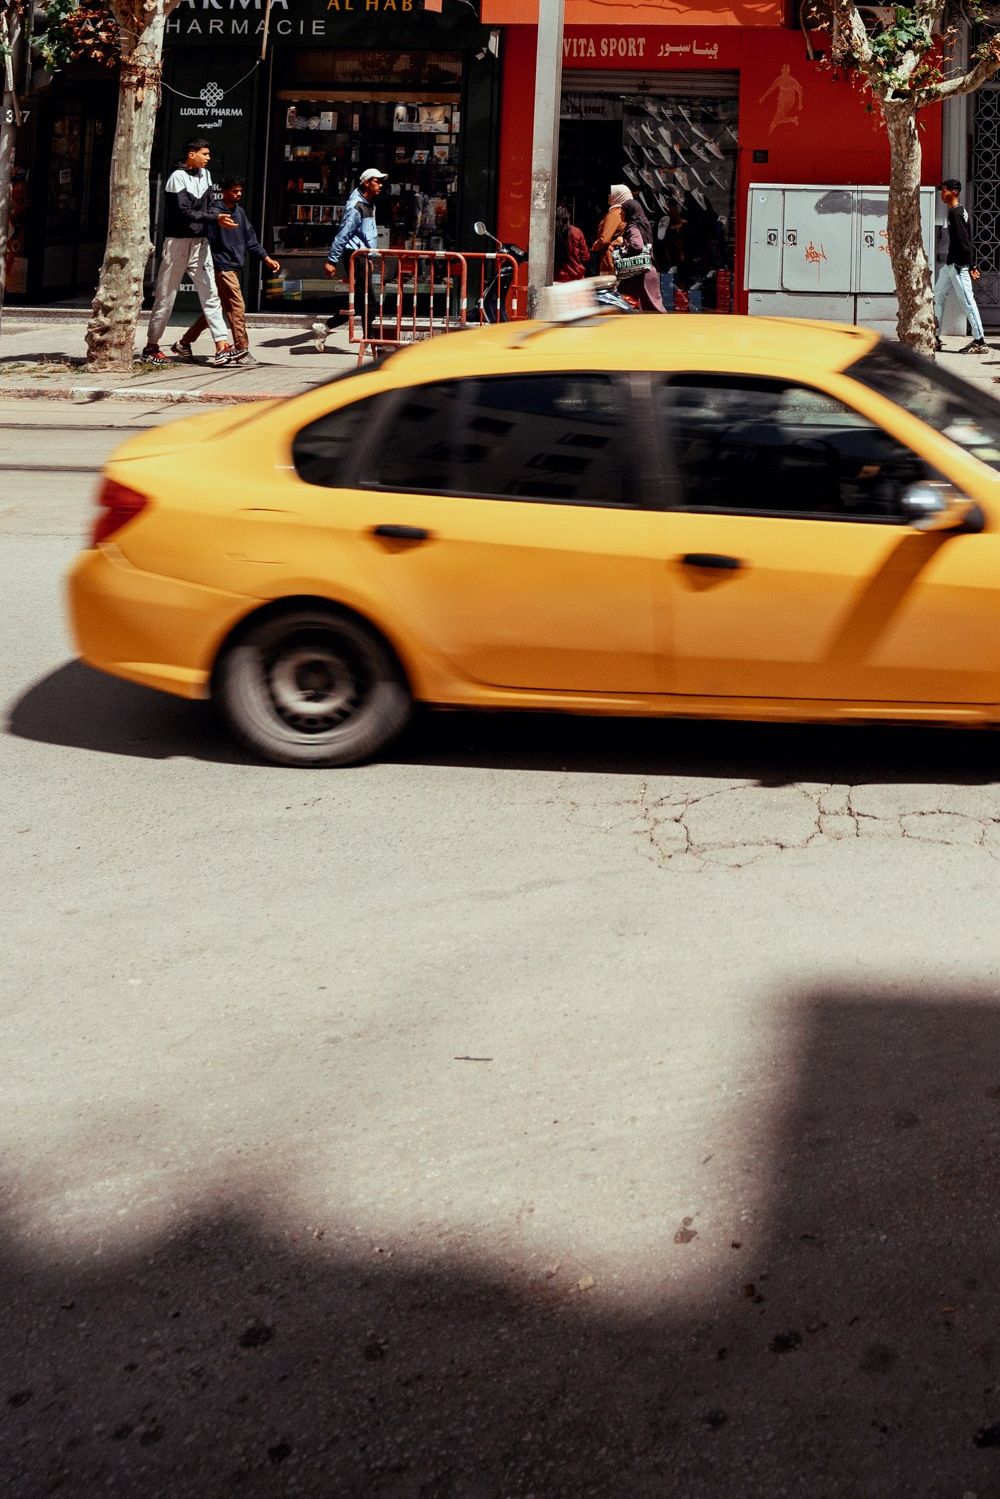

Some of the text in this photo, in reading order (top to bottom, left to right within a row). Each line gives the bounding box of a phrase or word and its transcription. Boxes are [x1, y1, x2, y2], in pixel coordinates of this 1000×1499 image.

[563, 37, 646, 58] VITA SPORT
[180, 108, 243, 117] LUXURY PHARMA
